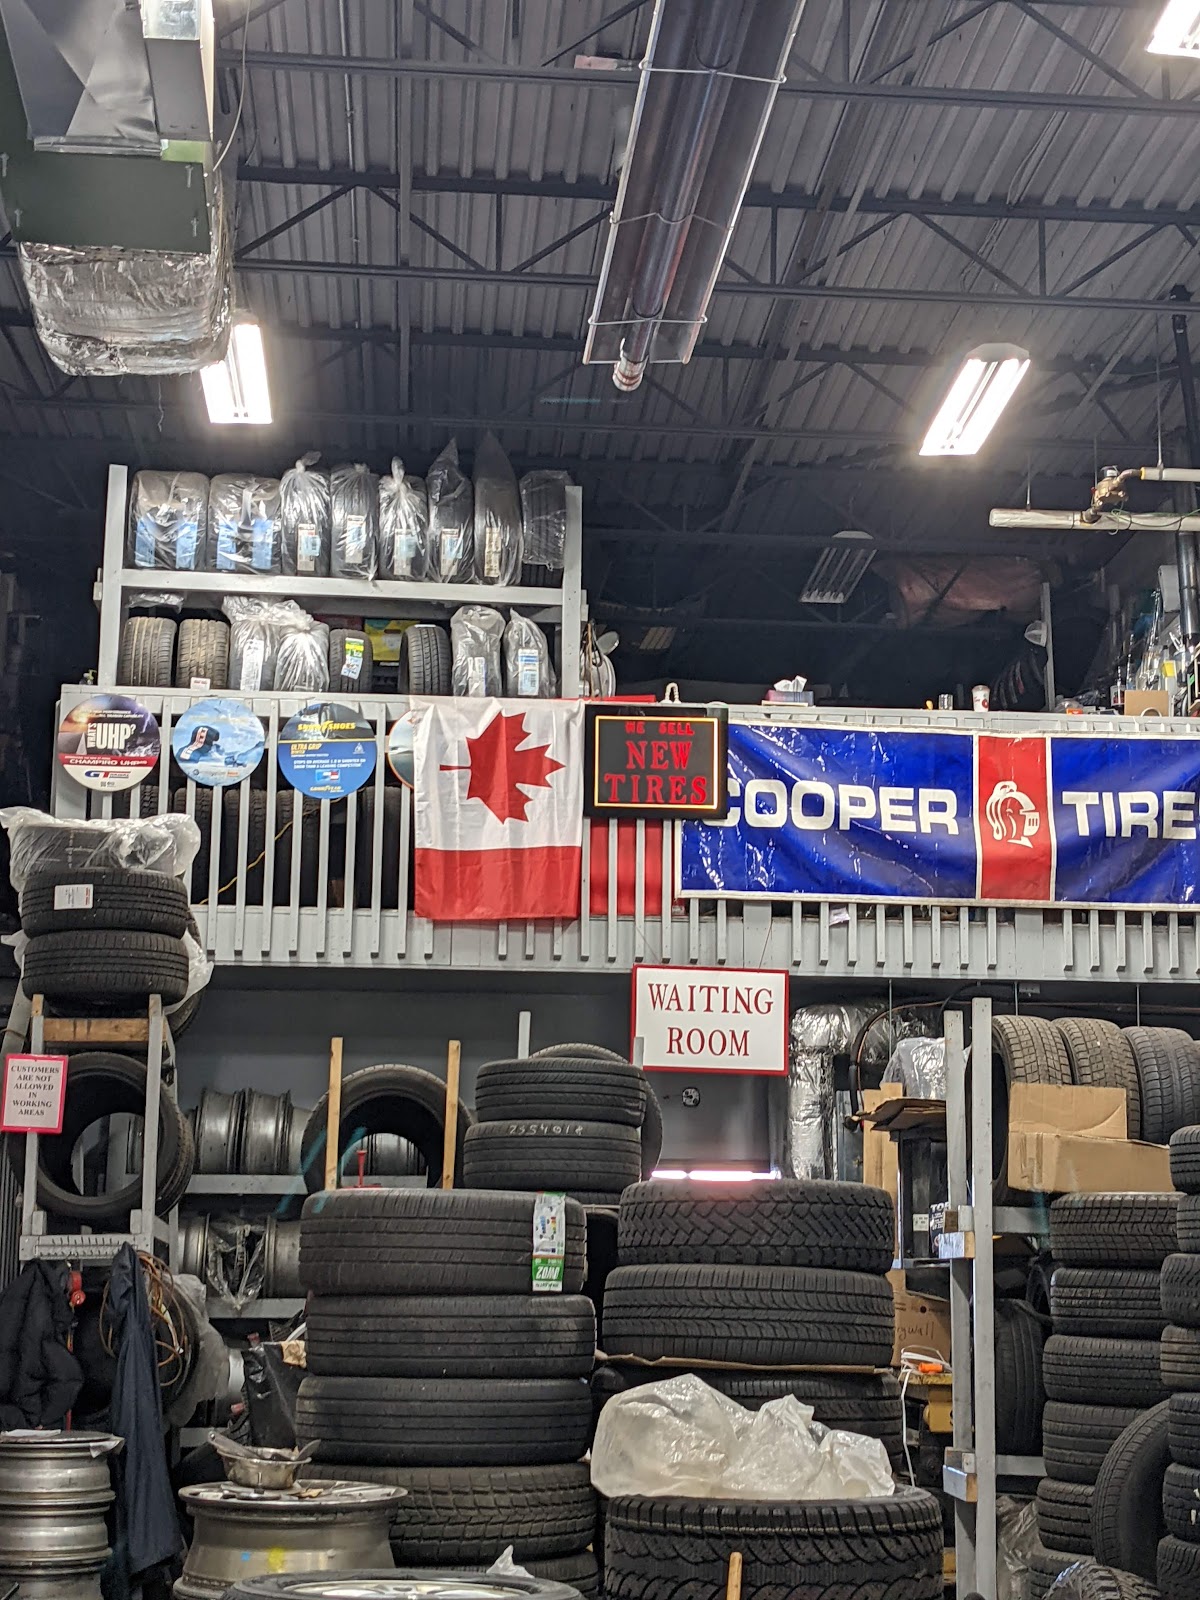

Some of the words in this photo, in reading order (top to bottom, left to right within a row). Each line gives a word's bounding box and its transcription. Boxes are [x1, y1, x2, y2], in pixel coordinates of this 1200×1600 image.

[328, 722, 356, 731] SHOES
[624, 721, 645, 734] WE
[658, 722, 695, 736] SELL
[625, 740, 693, 770] NEW
[603, 773, 707, 805] TIRES
[1062, 790, 1200, 840] TIRE
[648, 983, 774, 1015] WAITING
[666, 1026, 750, 1057] ROOM
[10, 1065, 60, 1074] CUSTOMERS
[13, 1082, 54, 1091] ALLOWED
[12, 1099, 53, 1108] WORKING
